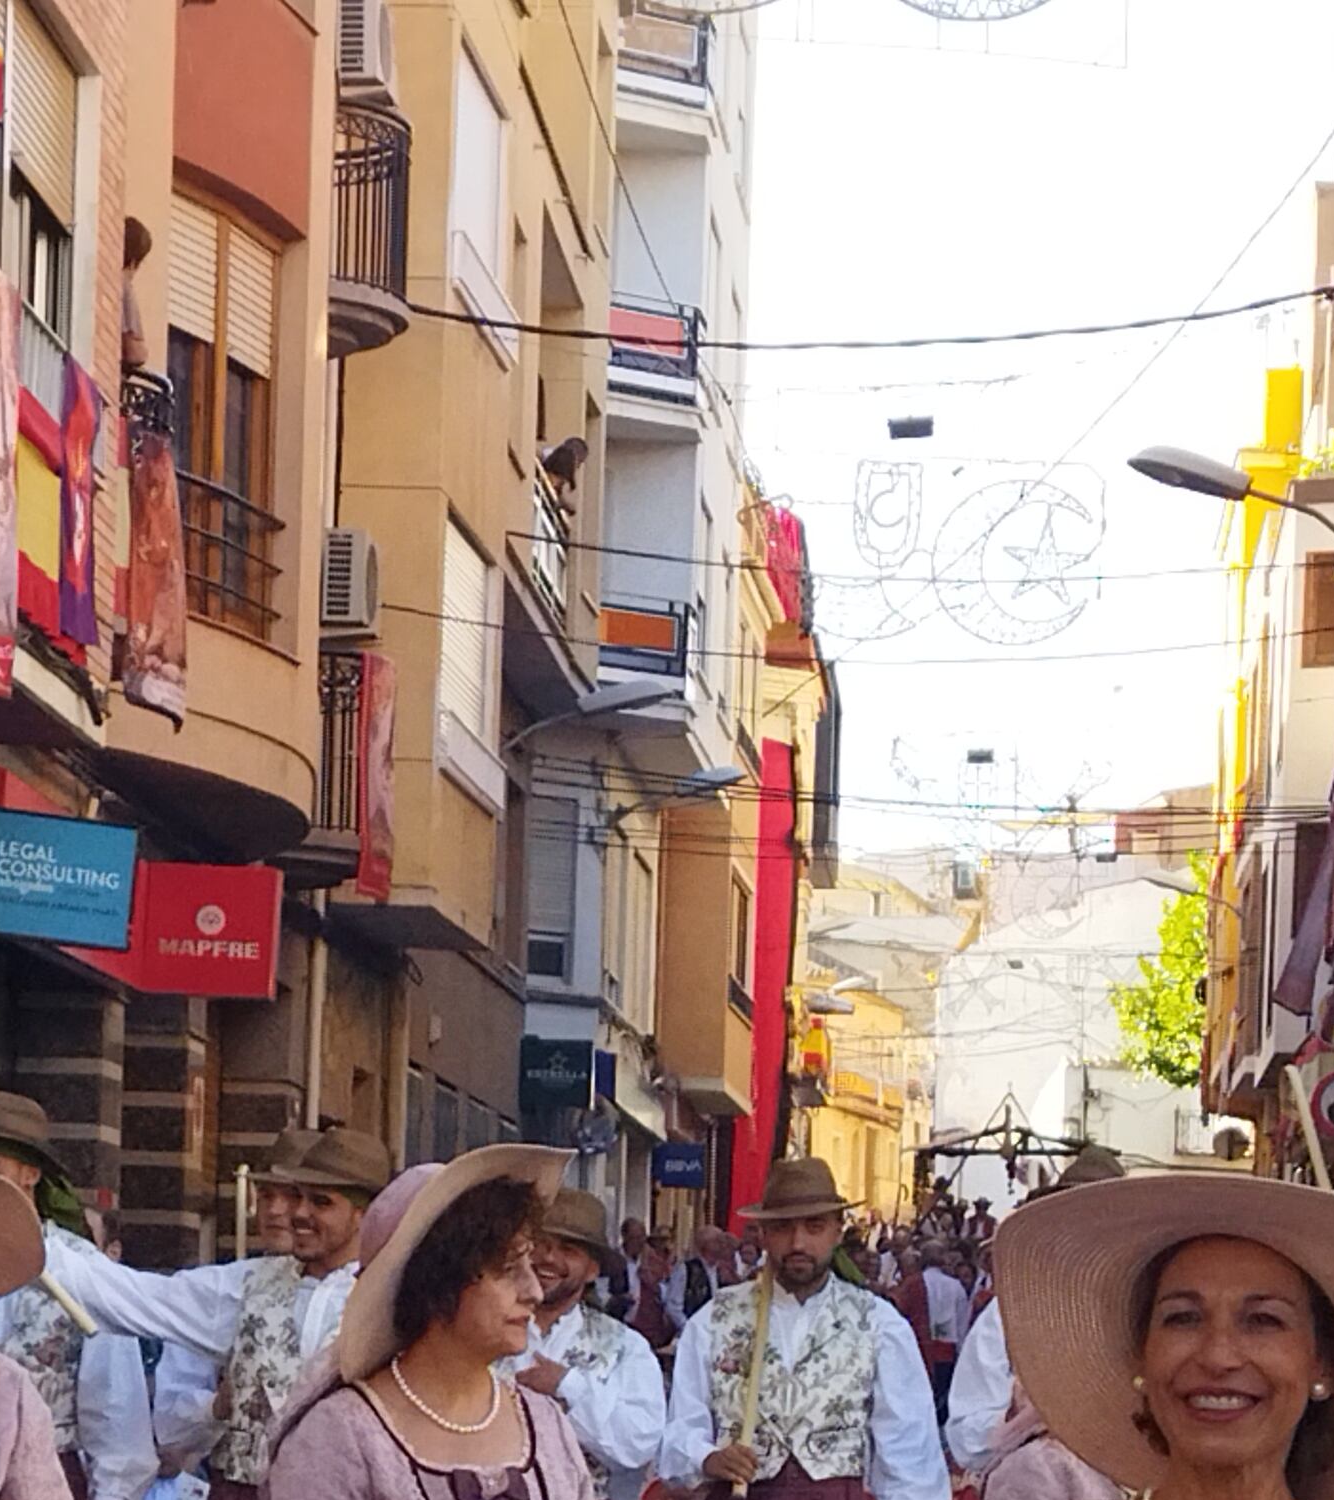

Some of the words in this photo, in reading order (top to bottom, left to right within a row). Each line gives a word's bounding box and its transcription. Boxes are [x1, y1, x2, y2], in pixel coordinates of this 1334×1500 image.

[158, 937, 260, 960] MAPFRE
[527, 1068, 588, 1080] ESTRELLA
[664, 1159, 703, 1173] BBVA
